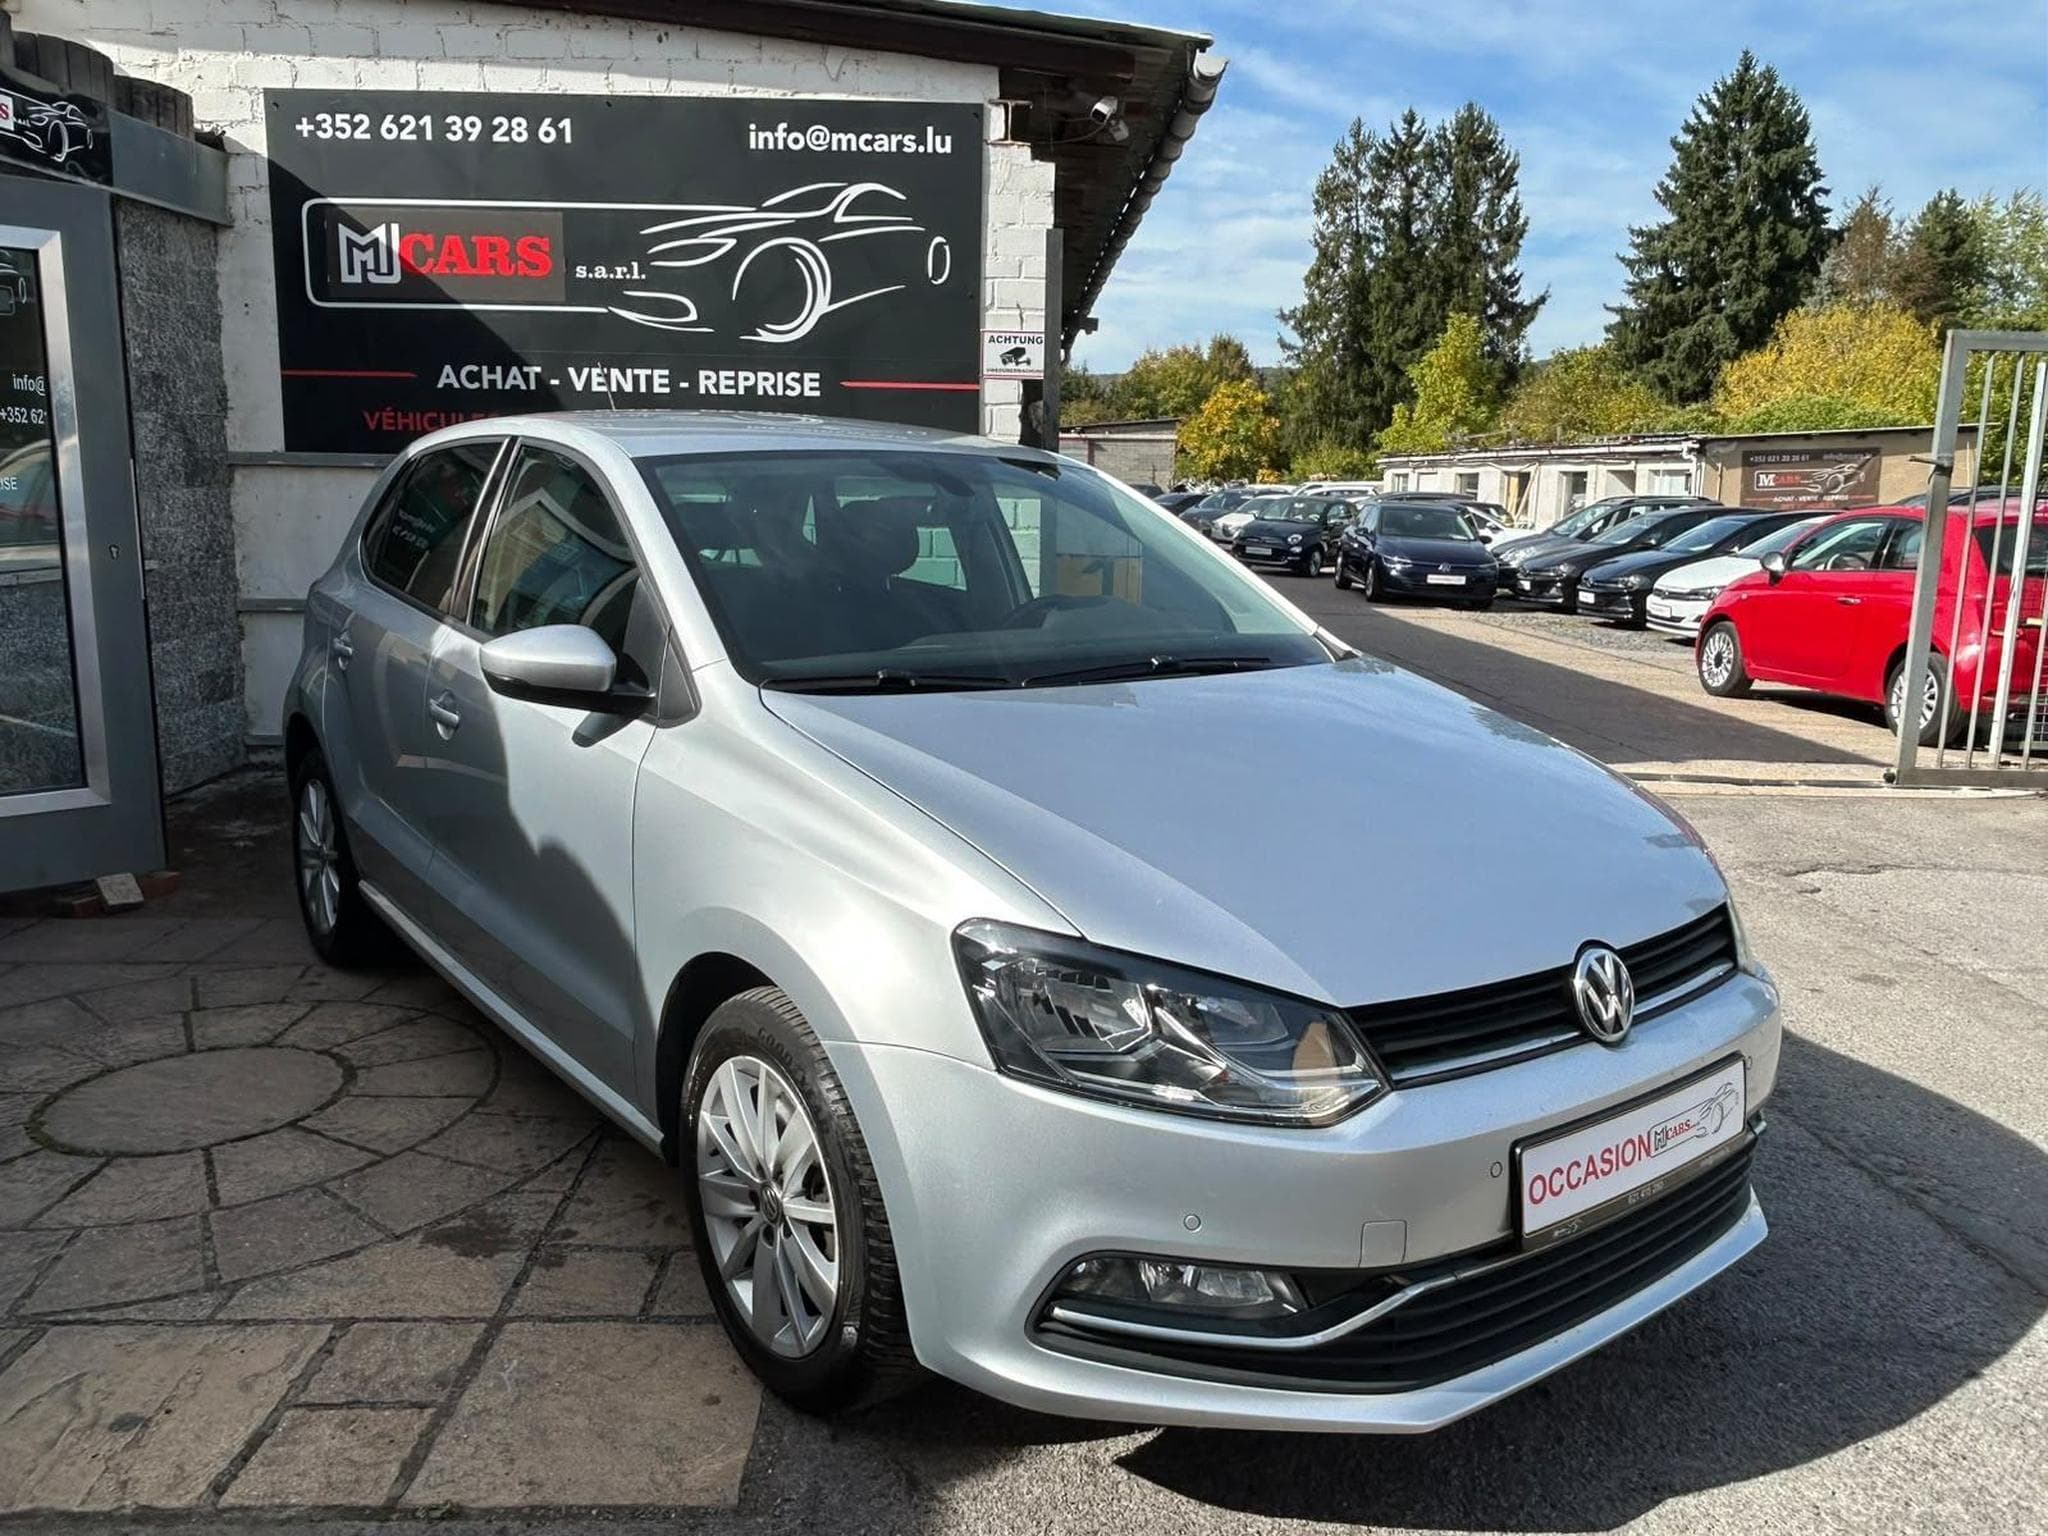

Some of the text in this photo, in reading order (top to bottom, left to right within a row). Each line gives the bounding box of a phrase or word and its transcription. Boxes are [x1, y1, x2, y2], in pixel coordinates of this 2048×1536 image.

[295, 113, 573, 144] +352 621 39 28 61
[748, 123, 953, 155] info@mcars.lu
[574, 262, 648, 281] s.a.r.l.
[988, 335, 1043, 345] ACHTUNG
[436, 364, 542, 391] ACHAT
[567, 367, 671, 394] VENTE
[698, 370, 822, 397] REPRISE
[30, 408, 48, 424] 62
[1528, 1131, 1651, 1205] OCCASION
